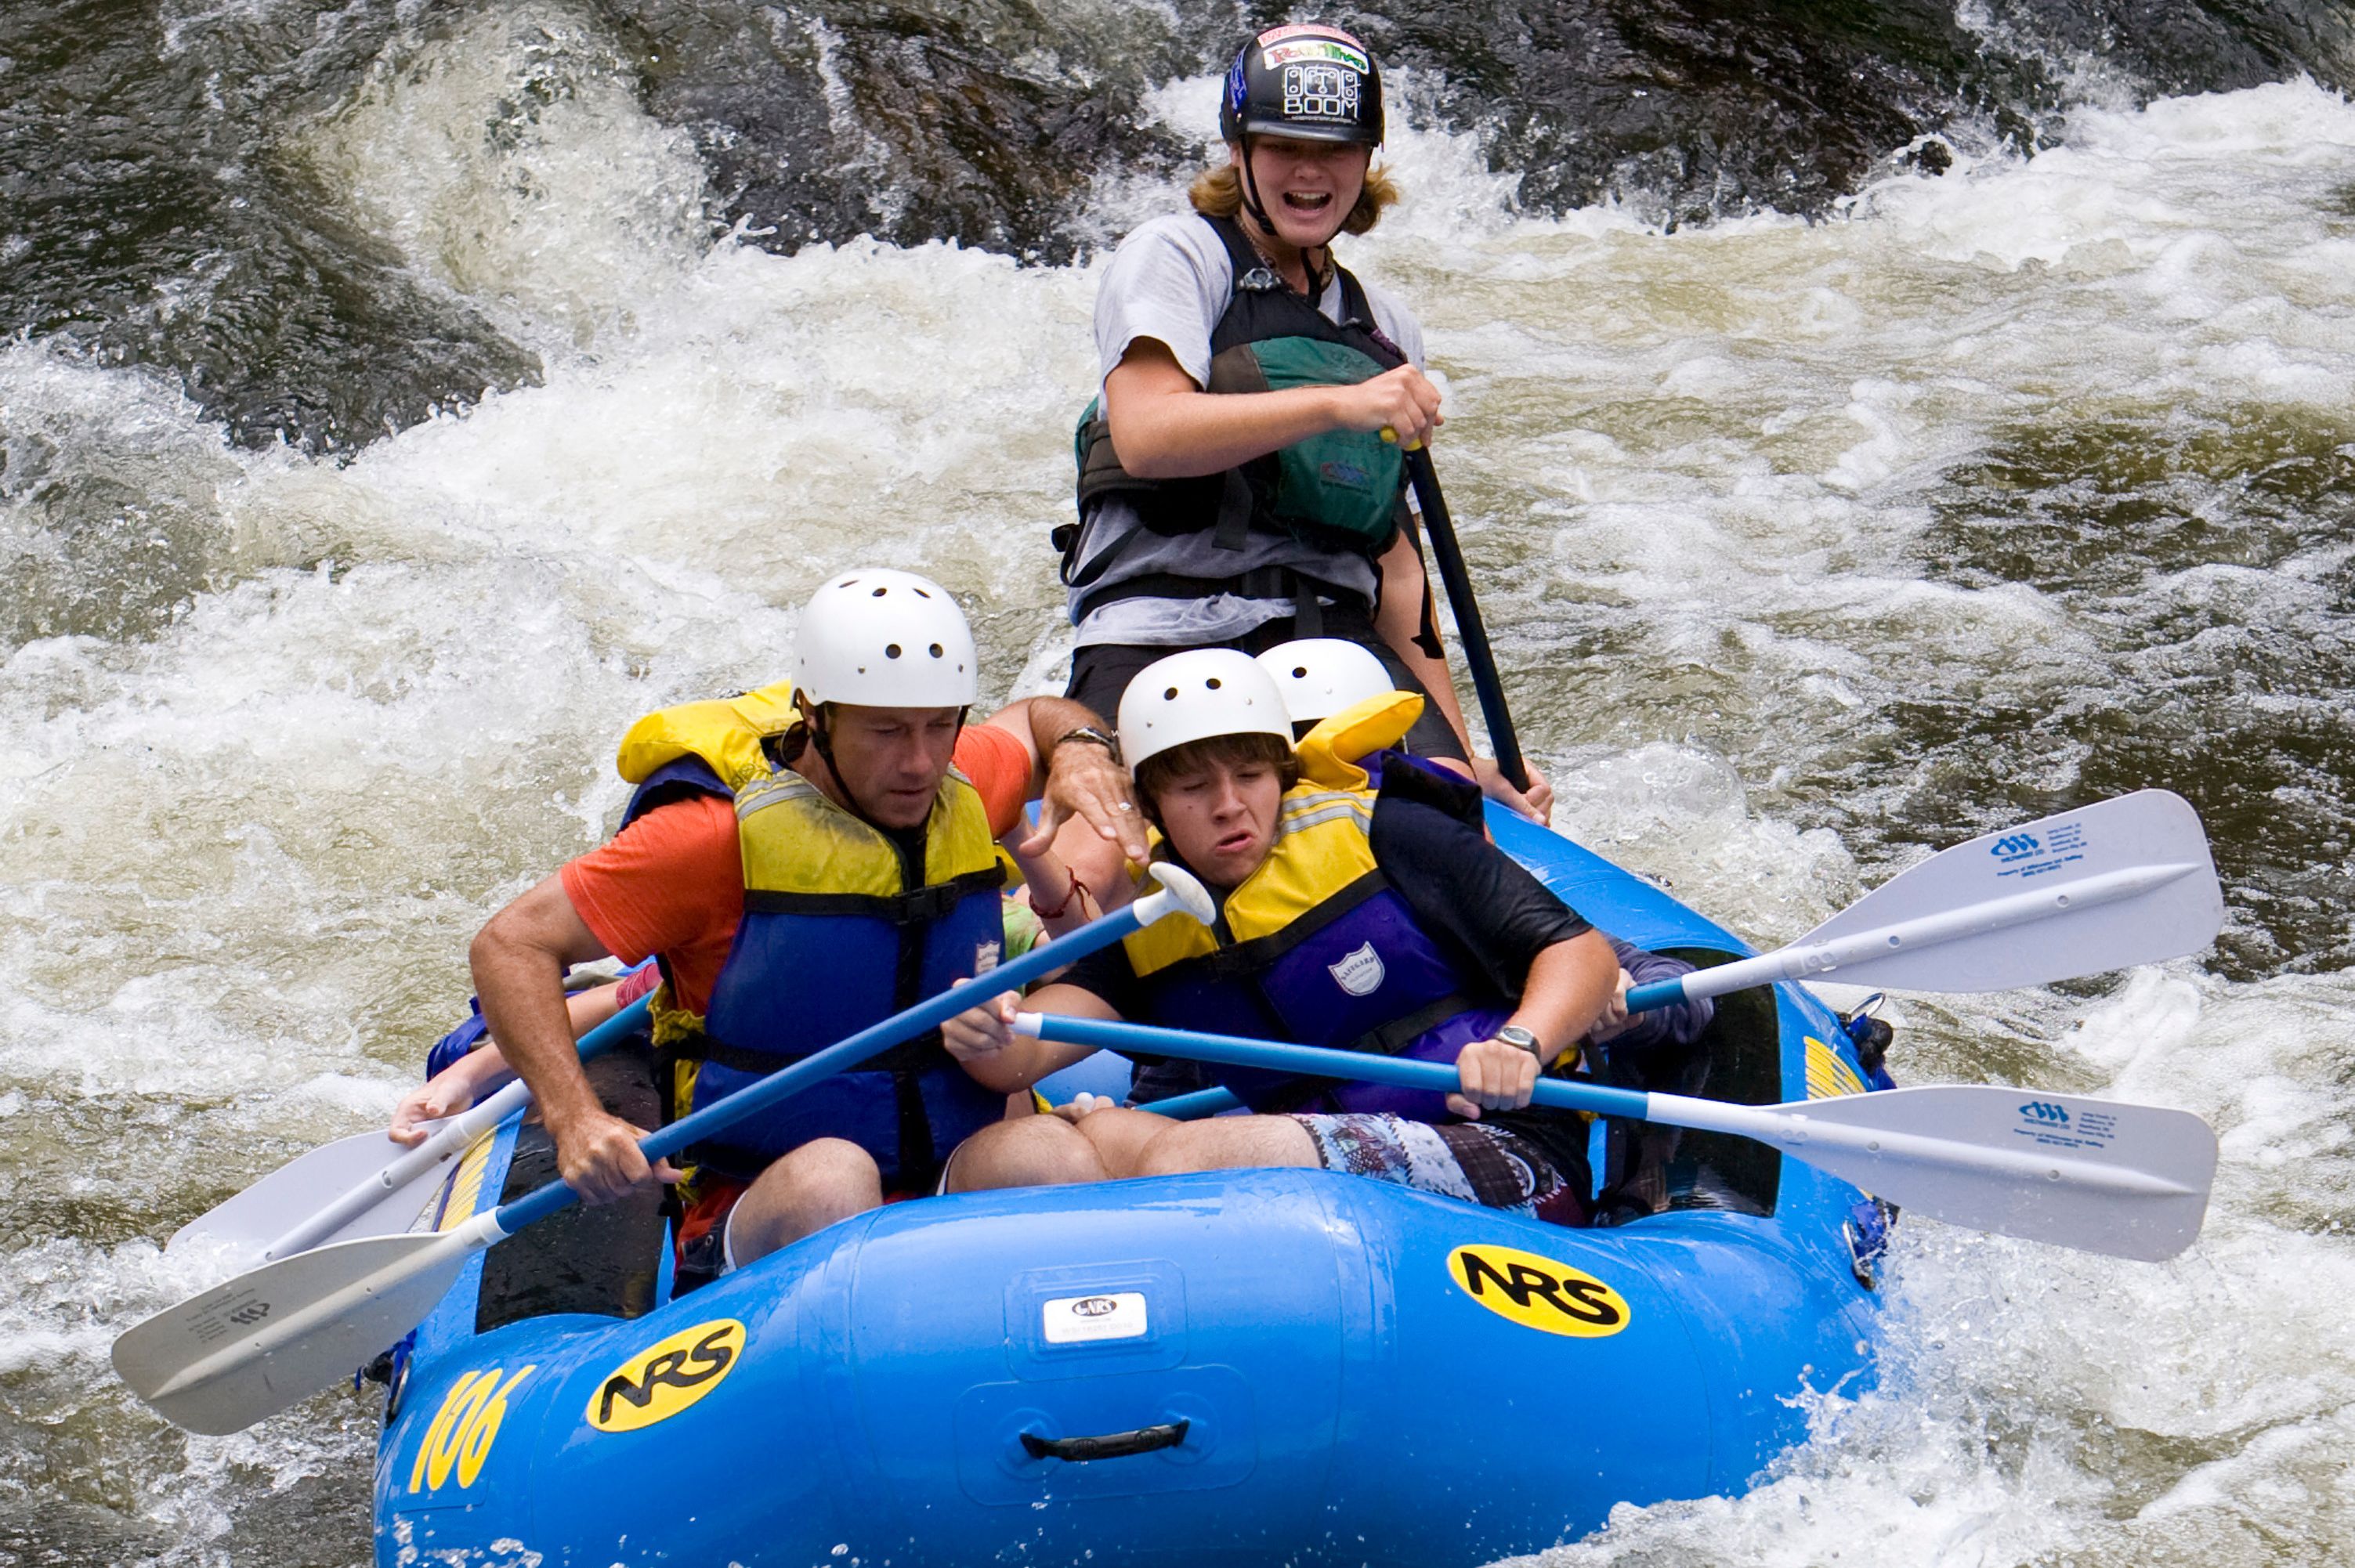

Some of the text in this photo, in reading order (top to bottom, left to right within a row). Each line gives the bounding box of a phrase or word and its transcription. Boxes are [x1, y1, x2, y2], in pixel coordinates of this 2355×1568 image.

[1283, 96, 1358, 118] BOOM
[1460, 1251, 1621, 1325] NRS
[599, 1325, 734, 1425] NRS
[409, 1364, 537, 1494] 106
